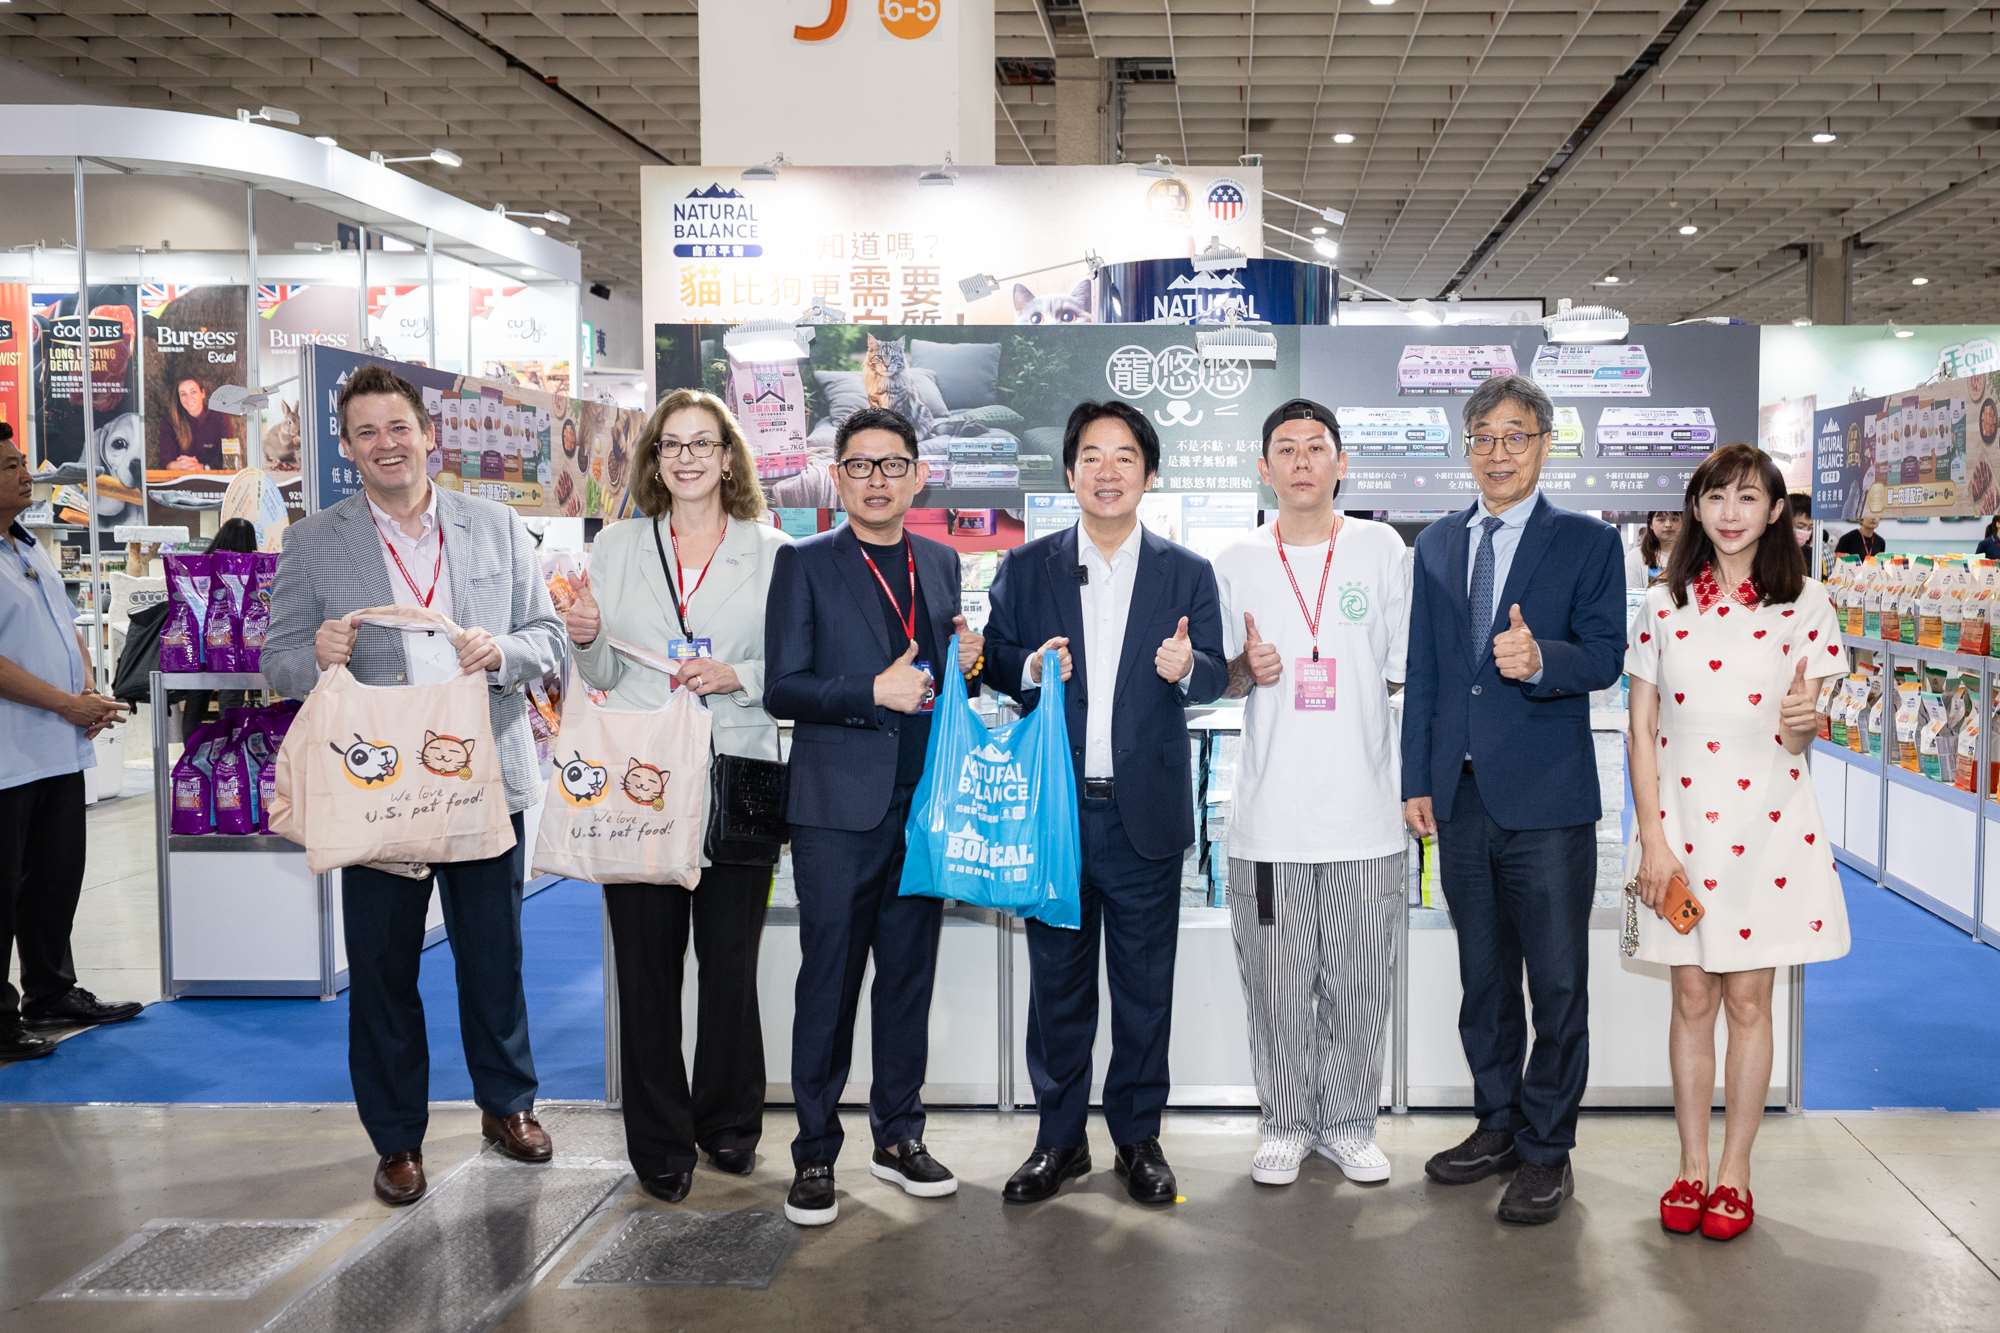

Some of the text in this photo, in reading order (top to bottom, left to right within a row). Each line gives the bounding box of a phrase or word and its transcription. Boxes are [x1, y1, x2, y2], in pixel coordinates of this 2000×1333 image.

[674, 203, 759, 222] NATURAL
[674, 223, 759, 239] BALANCE
[1153, 294, 1260, 320] NATUAL
[157, 326, 236, 350] Burgess
[49, 348, 116, 360] LONG LSTING
[1818, 434, 1844, 454] NATURAL
[1817, 453, 1844, 470] BALANCE
[390, 785, 444, 802] We love
[958, 776, 1029, 804] BLANCE
[411, 798, 440, 820] pet
[446, 784, 485, 814] food!
[593, 810, 638, 824] We love
[609, 824, 633, 841] pet
[637, 819, 675, 842] food!
